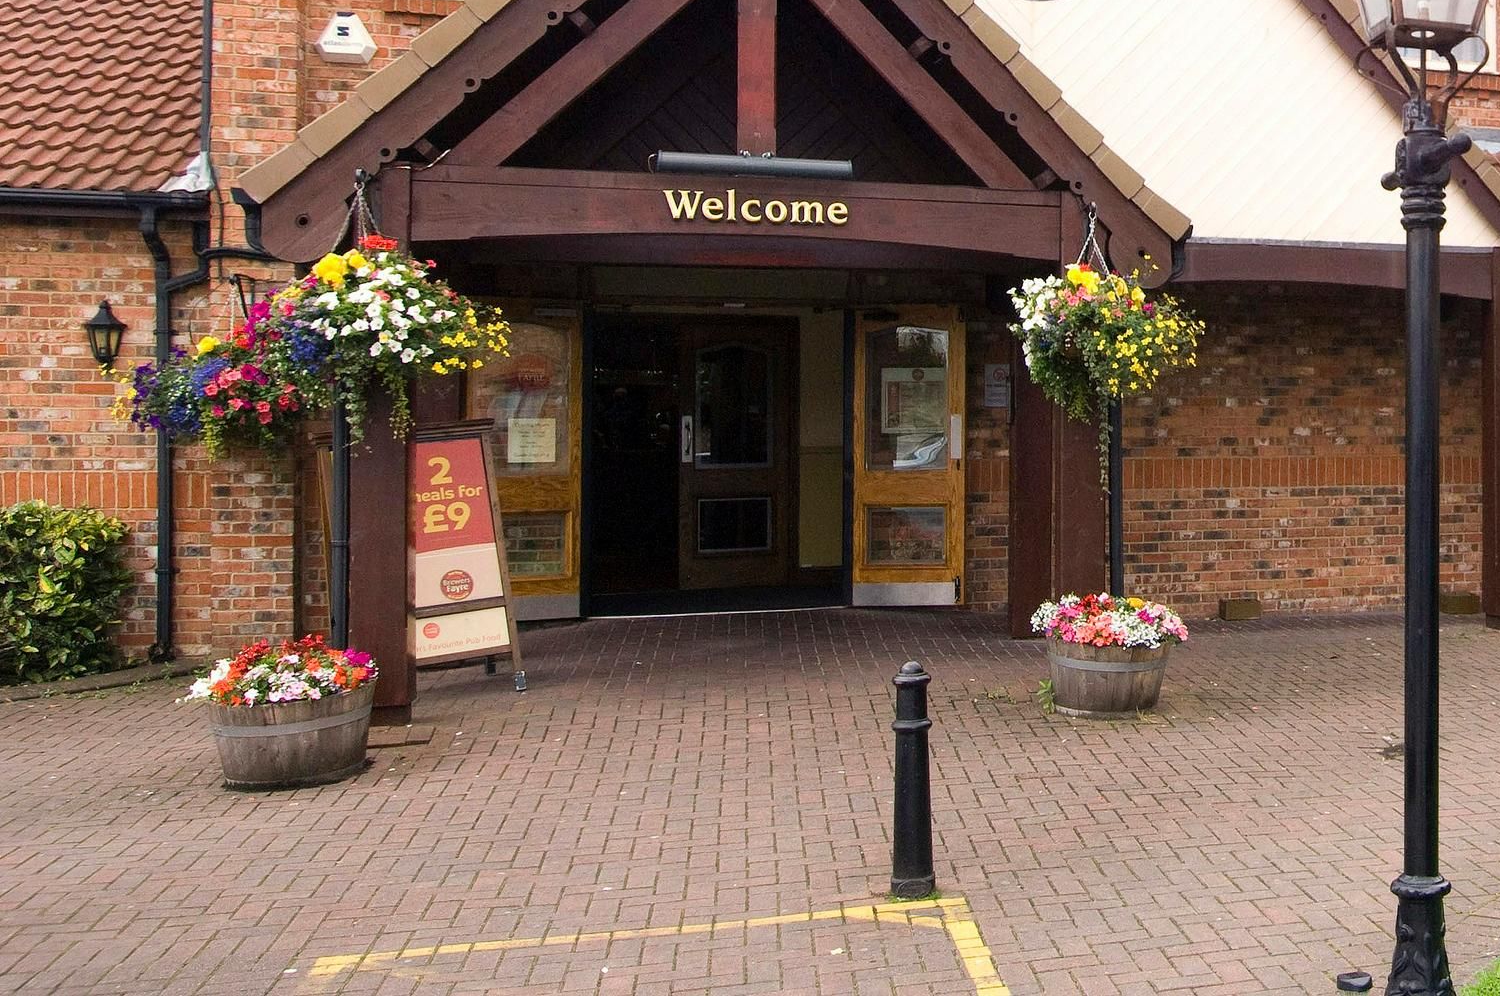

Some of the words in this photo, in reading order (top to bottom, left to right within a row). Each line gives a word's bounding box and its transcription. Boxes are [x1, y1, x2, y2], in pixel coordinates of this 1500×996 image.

[663, 188, 849, 225] Welcome
[428, 456, 453, 485] 2
[458, 484, 483, 498] for
[423, 501, 471, 534] £9
[446, 583, 469, 593] Fayre
[465, 636, 481, 645] Pub
[482, 633, 501, 643] Food
